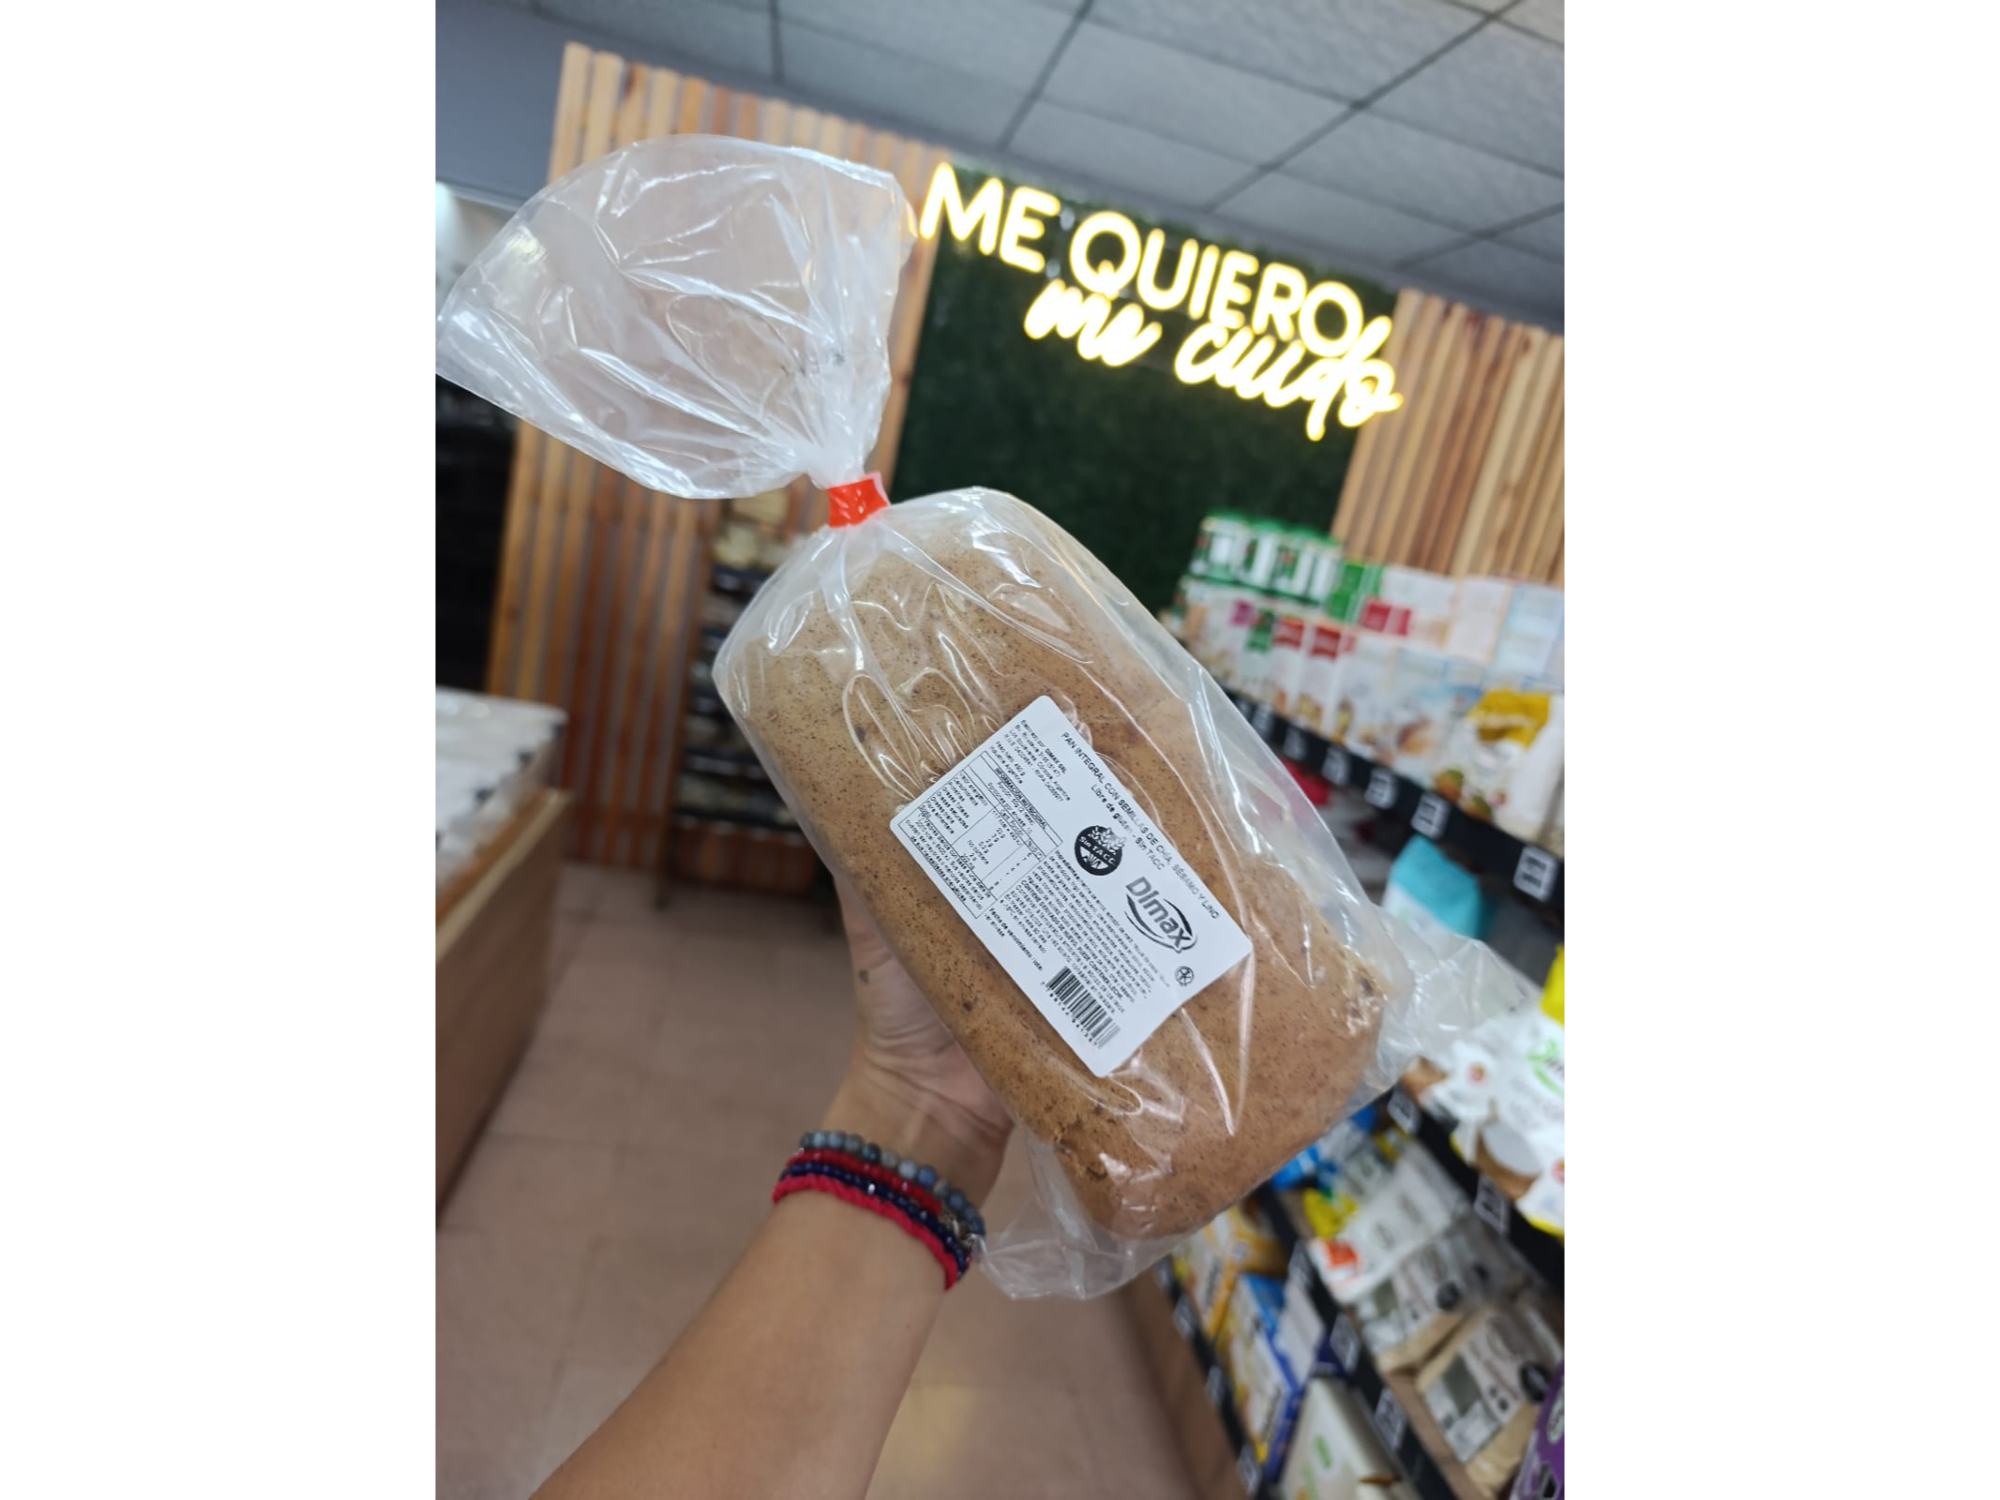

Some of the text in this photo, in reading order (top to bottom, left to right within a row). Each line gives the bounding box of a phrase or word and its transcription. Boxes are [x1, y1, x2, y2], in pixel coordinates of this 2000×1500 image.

[919, 161, 1364, 358] ME QUIERO
[1023, 277, 1163, 367] me
[1060, 731, 1077, 749] PAN
[1074, 746, 1107, 784] INTEGRAL
[1103, 781, 1120, 800] CON
[1117, 798, 1149, 834] SEMILLAS
[1145, 831, 1158, 846] DE
[1171, 862, 1200, 895] SÉSAMO
[1196, 893, 1205, 902] Y
[1201, 899, 1220, 920] LINO
[1077, 833, 1117, 870] Sin TACC
[1090, 783, 1108, 803] Libre
[1105, 801, 1116, 813] de
[1111, 811, 1134, 836] gluten
[1134, 836, 1148, 851] Sin
[1144, 848, 1164, 871] TACC
[1124, 871, 1195, 951] Dimax
